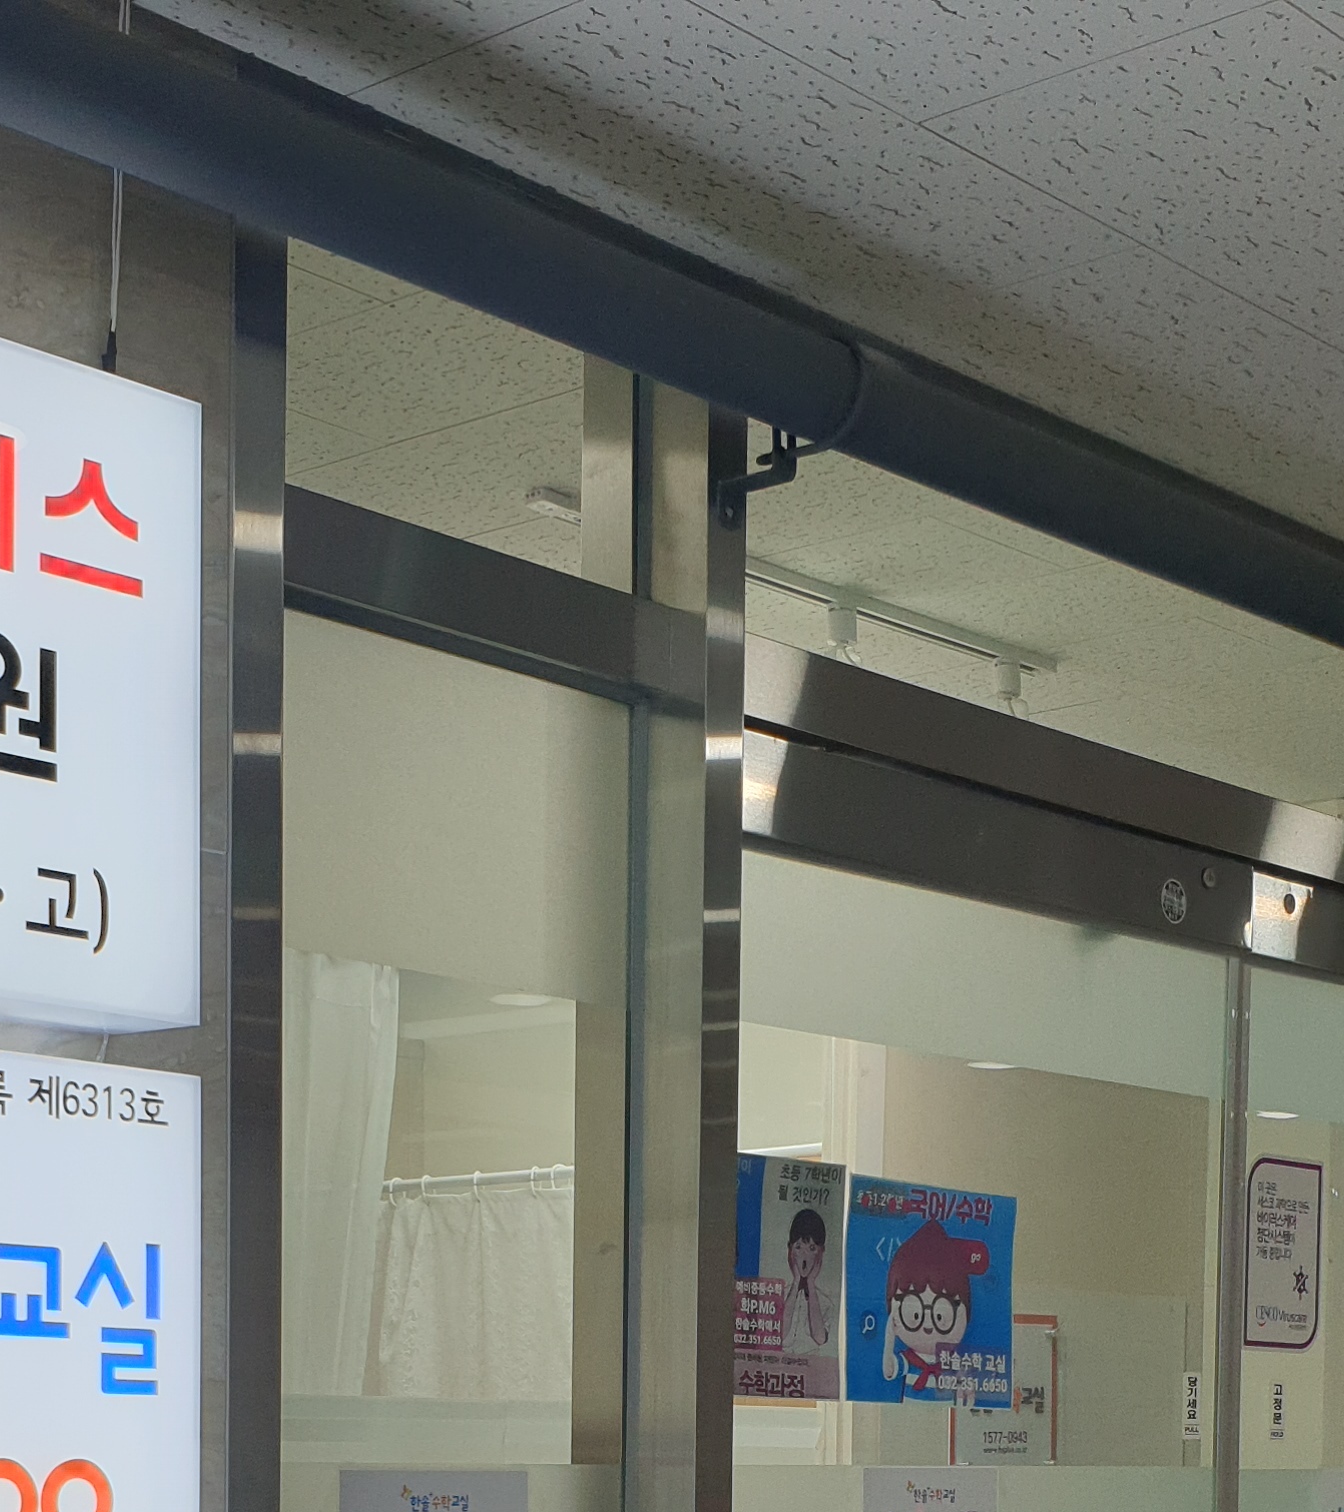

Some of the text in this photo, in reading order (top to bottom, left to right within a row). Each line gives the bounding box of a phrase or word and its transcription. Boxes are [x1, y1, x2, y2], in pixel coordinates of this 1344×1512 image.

[26, 1075, 169, 1128] 제6313호
[780, 1164, 800, 1181] 초등
[940, 1350, 1006, 1374] 한솔수학 교실
[739, 1370, 805, 1398] 수학과정
[1186, 1376, 1197, 1420] 당기세요
[1273, 1384, 1283, 1425] 고정문
[983, 1431, 1027, 1444] 1577-0943
[1184, 1426, 1199, 1435] PULL
